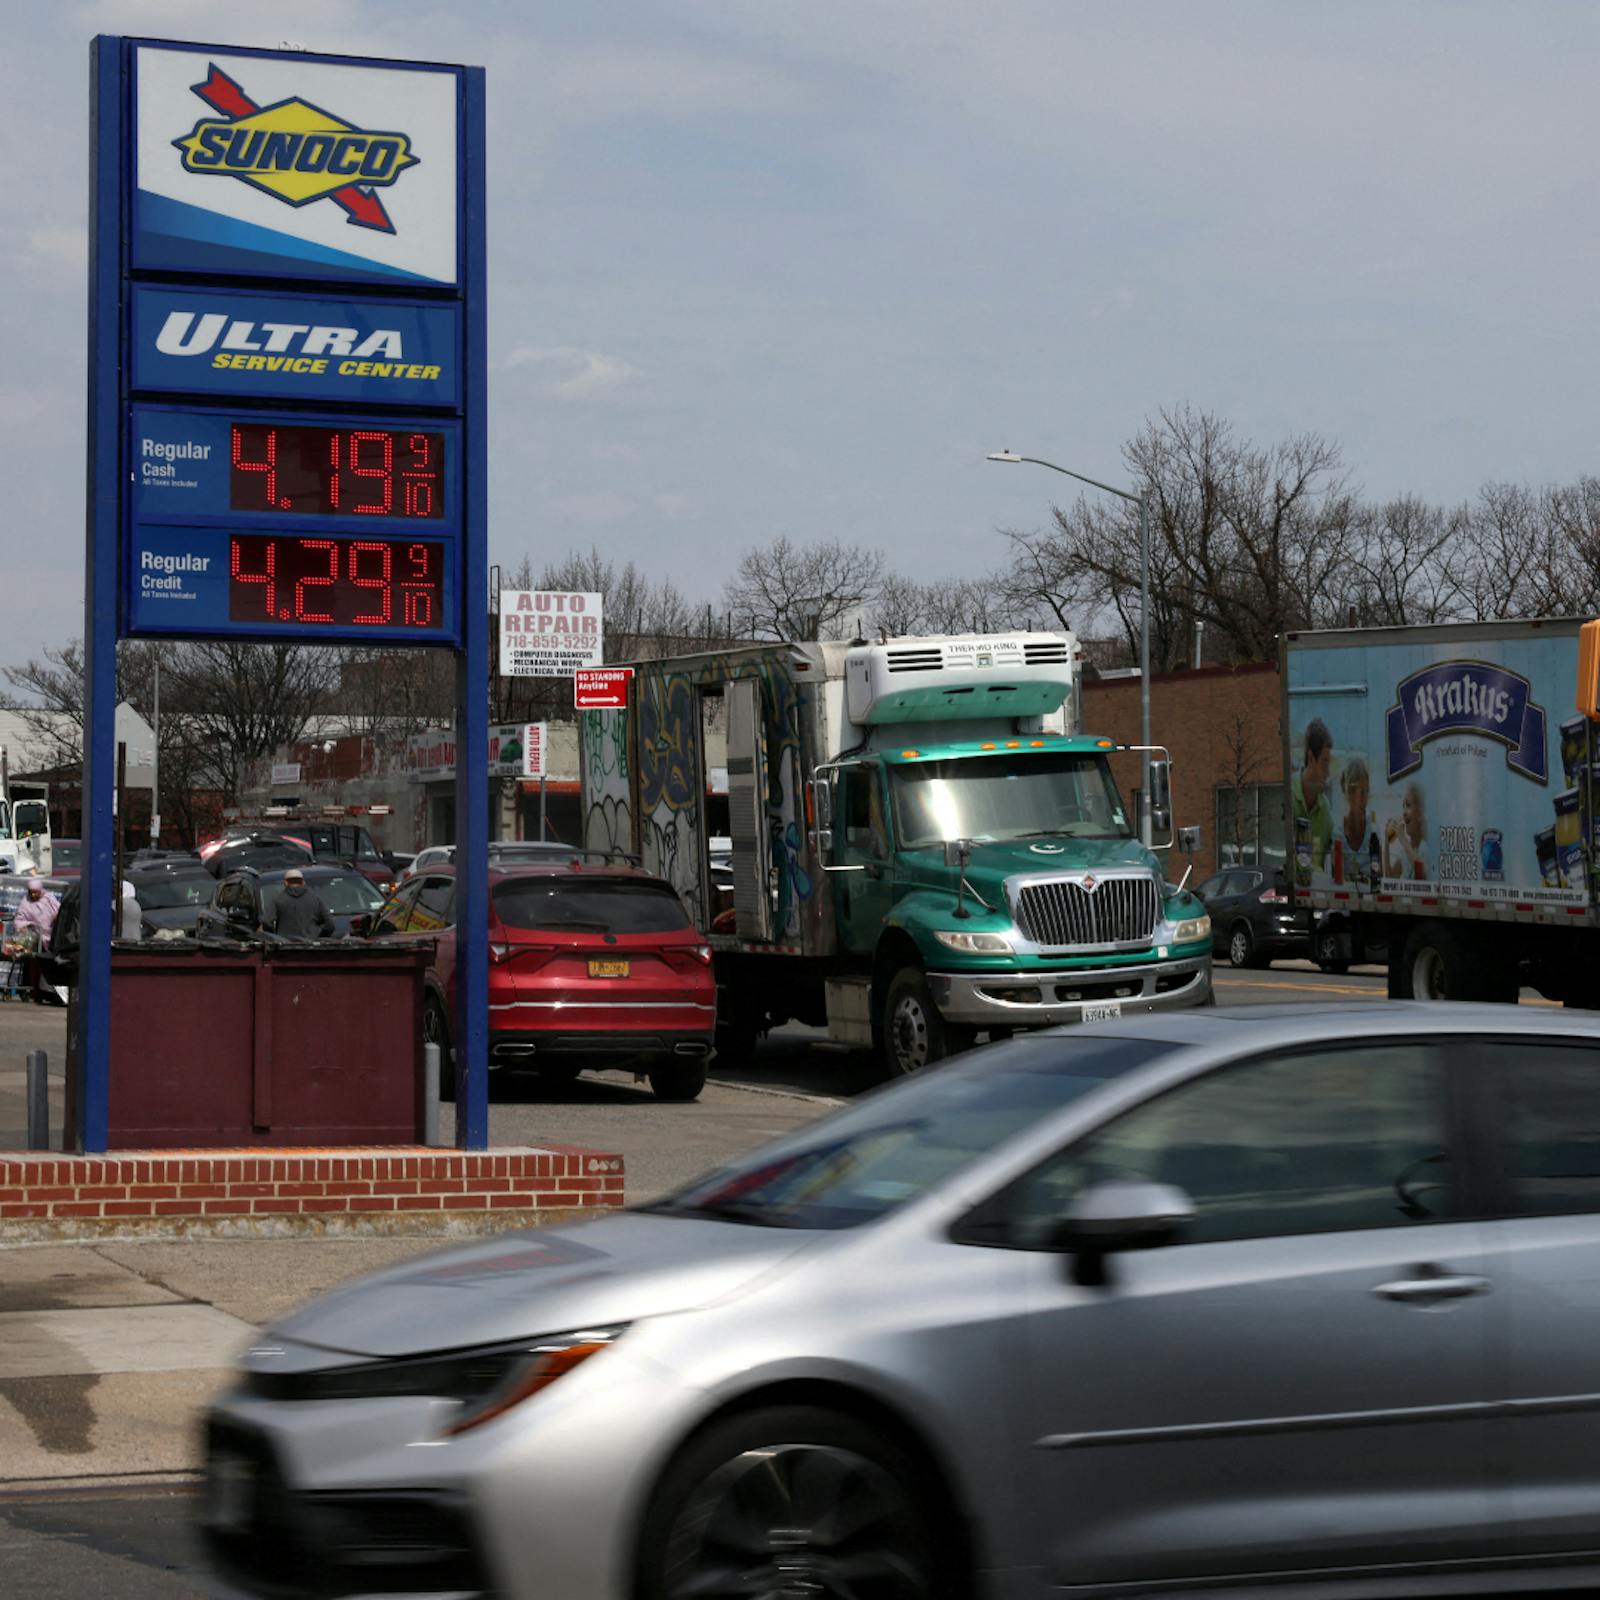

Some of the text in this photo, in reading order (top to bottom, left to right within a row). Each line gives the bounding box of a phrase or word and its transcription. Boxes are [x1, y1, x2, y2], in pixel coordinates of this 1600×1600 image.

[192, 127, 401, 178] SUNOCO
[155, 311, 403, 359] ULTRA
[211, 353, 441, 380] SERVICE CENTER
[141, 438, 211, 461] Regular
[142, 463, 175, 477] Cash
[171, 480, 198, 488] Included
[141, 550, 211, 574] Regular
[141, 574, 182, 590] Credit
[170, 592, 197, 600] Included
[516, 593, 586, 613] AUTO
[505, 614, 598, 633] REPAIR
[505, 635, 598, 650] 718-859-5292
[949, 642, 1017, 653] THERMO KING
[514, 650, 594, 659] COMPUTER DIAGNOSIS
[514, 667, 575, 675] ELECTRICAL WOR
[578, 672, 625, 681] NO STANDING
[1414, 673, 1510, 725] Krakus
[529, 725, 541, 773] AUTO REPAIR
[1439, 825, 1475, 853] PRIME
[1439, 853, 1478, 880] CHOICE
